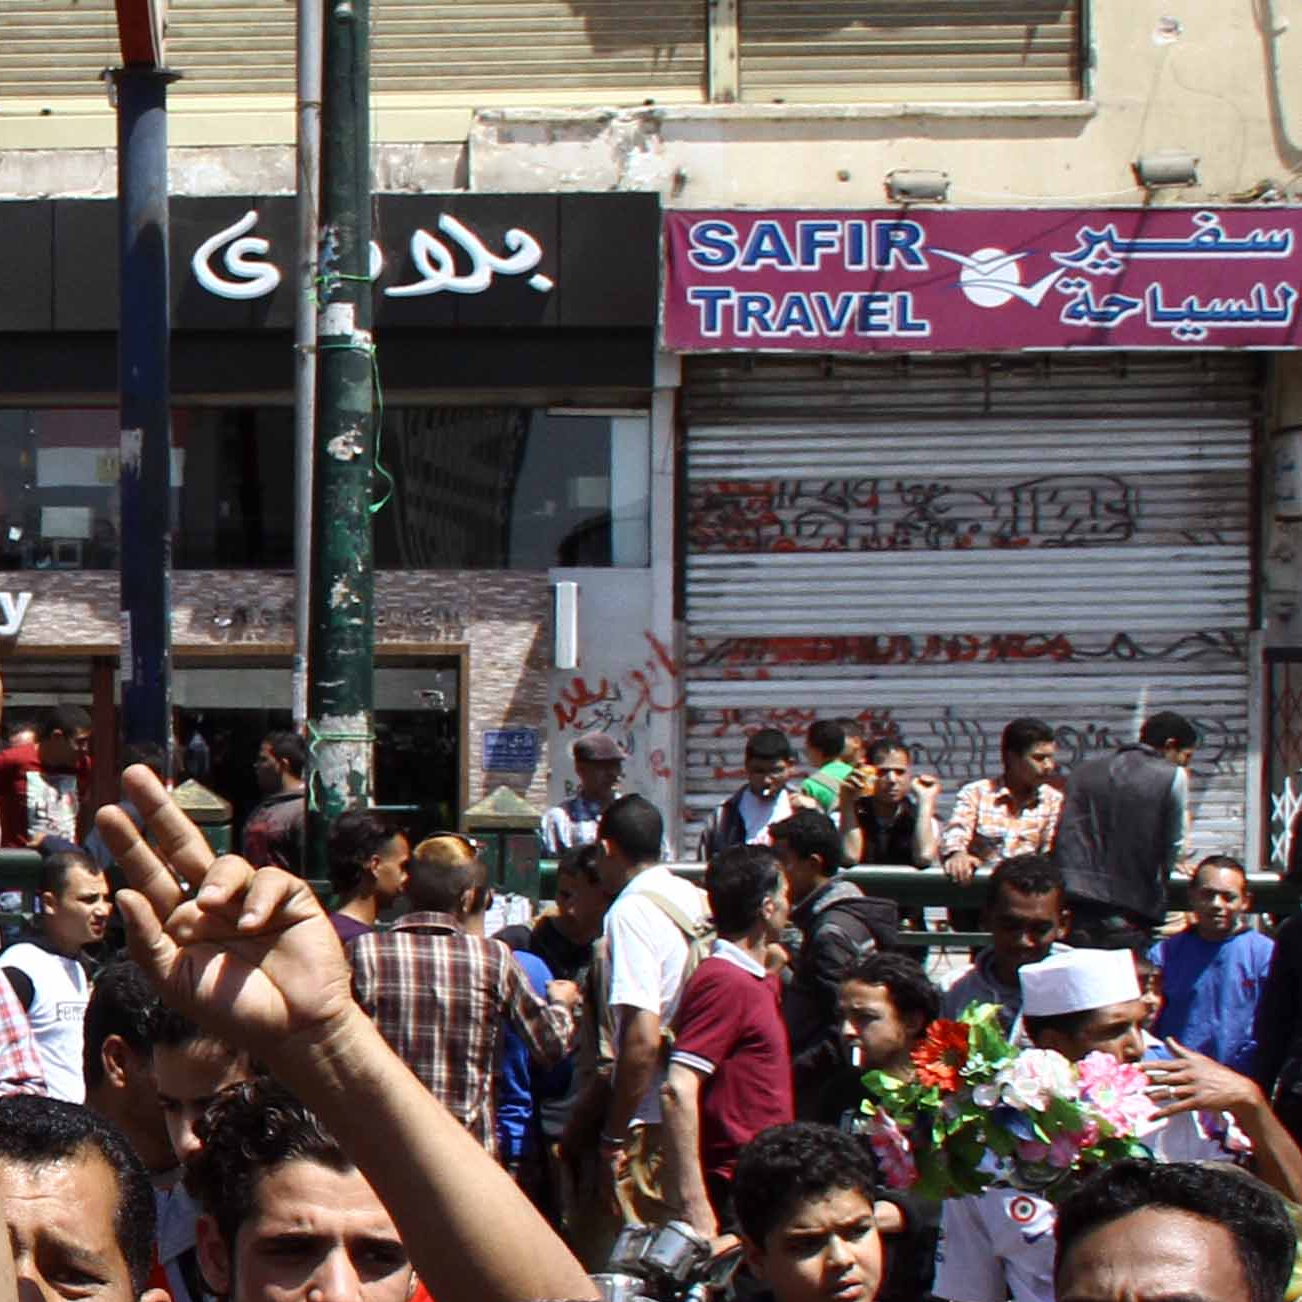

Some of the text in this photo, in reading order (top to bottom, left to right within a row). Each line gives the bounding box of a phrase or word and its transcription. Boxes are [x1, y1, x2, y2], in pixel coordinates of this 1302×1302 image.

[687, 218, 929, 273] SAFIR
[1050, 210, 1294, 275] سفير
[687, 286, 930, 338] TRAVEL
[1055, 275, 1299, 343] للسياحة
